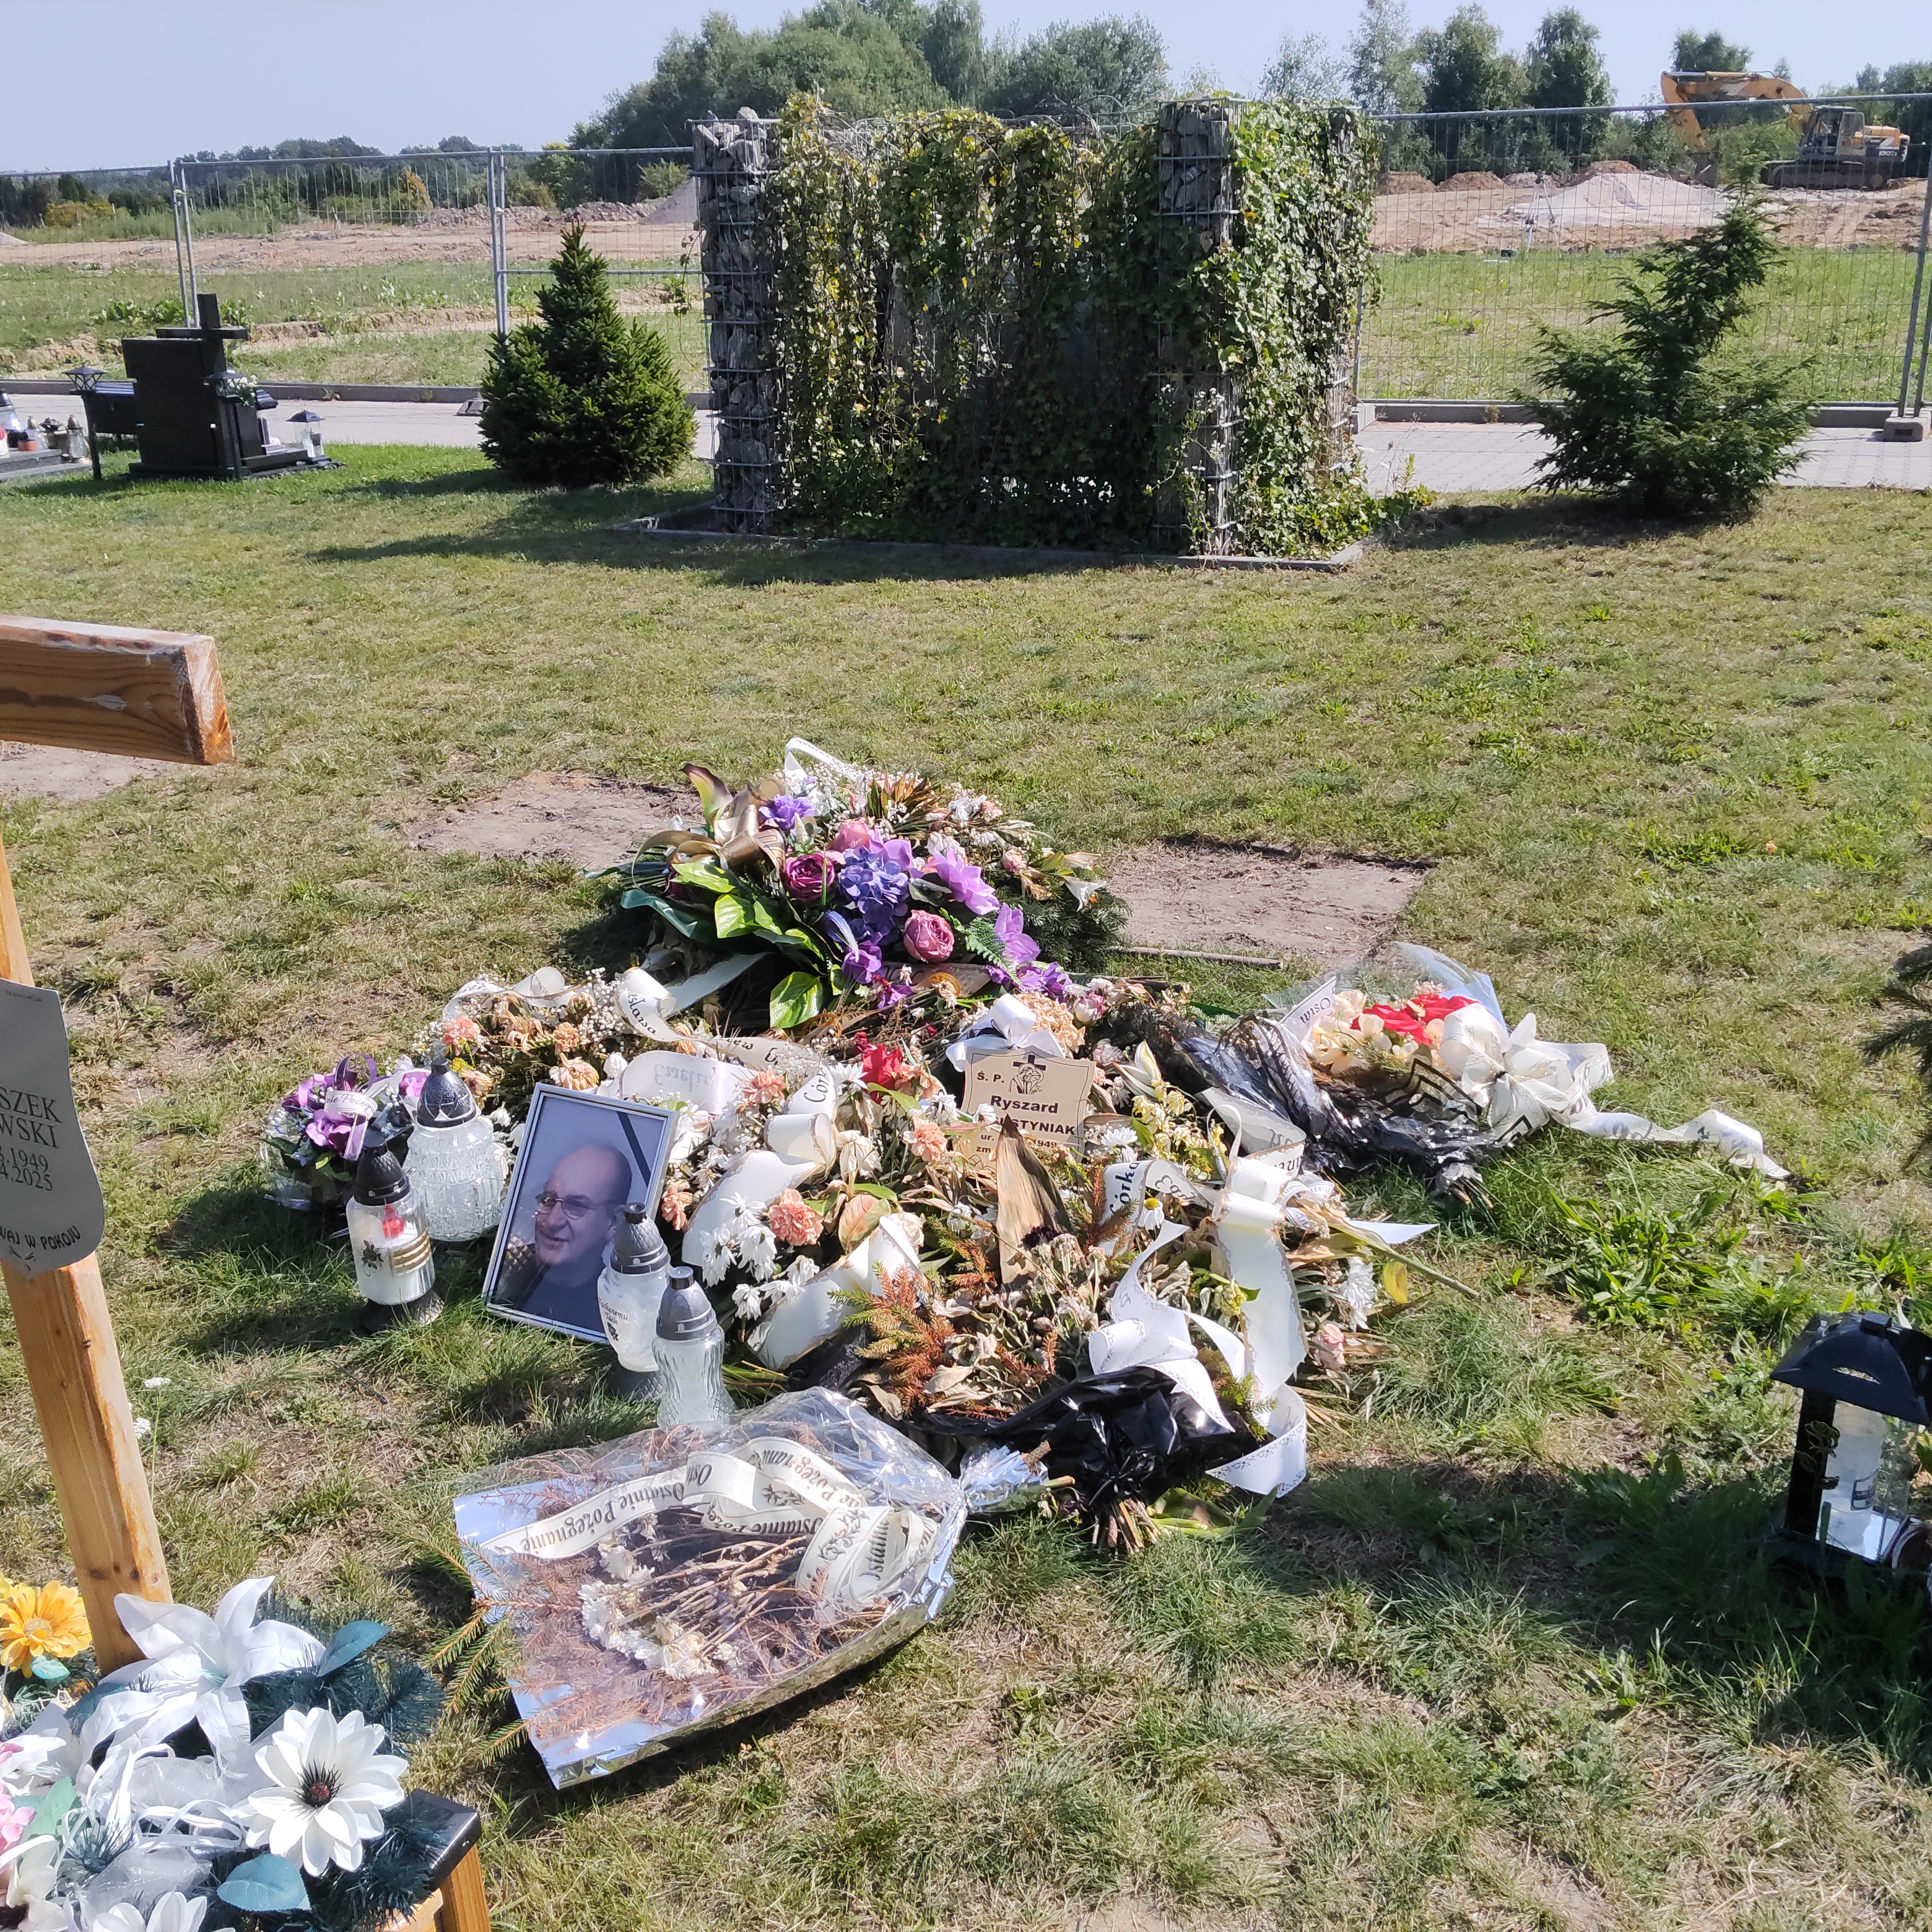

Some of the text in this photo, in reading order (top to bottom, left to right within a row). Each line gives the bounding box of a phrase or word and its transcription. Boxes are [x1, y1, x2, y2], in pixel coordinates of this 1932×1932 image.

[977, 1070, 1005, 1084] Ś. P.
[990, 1095, 1059, 1114] Ryszard
[25, 1234, 36, 1249] W
[40, 1225, 81, 1250] POKOJU
[521, 1481, 684, 1555] Ostatnie Pożegnanie
